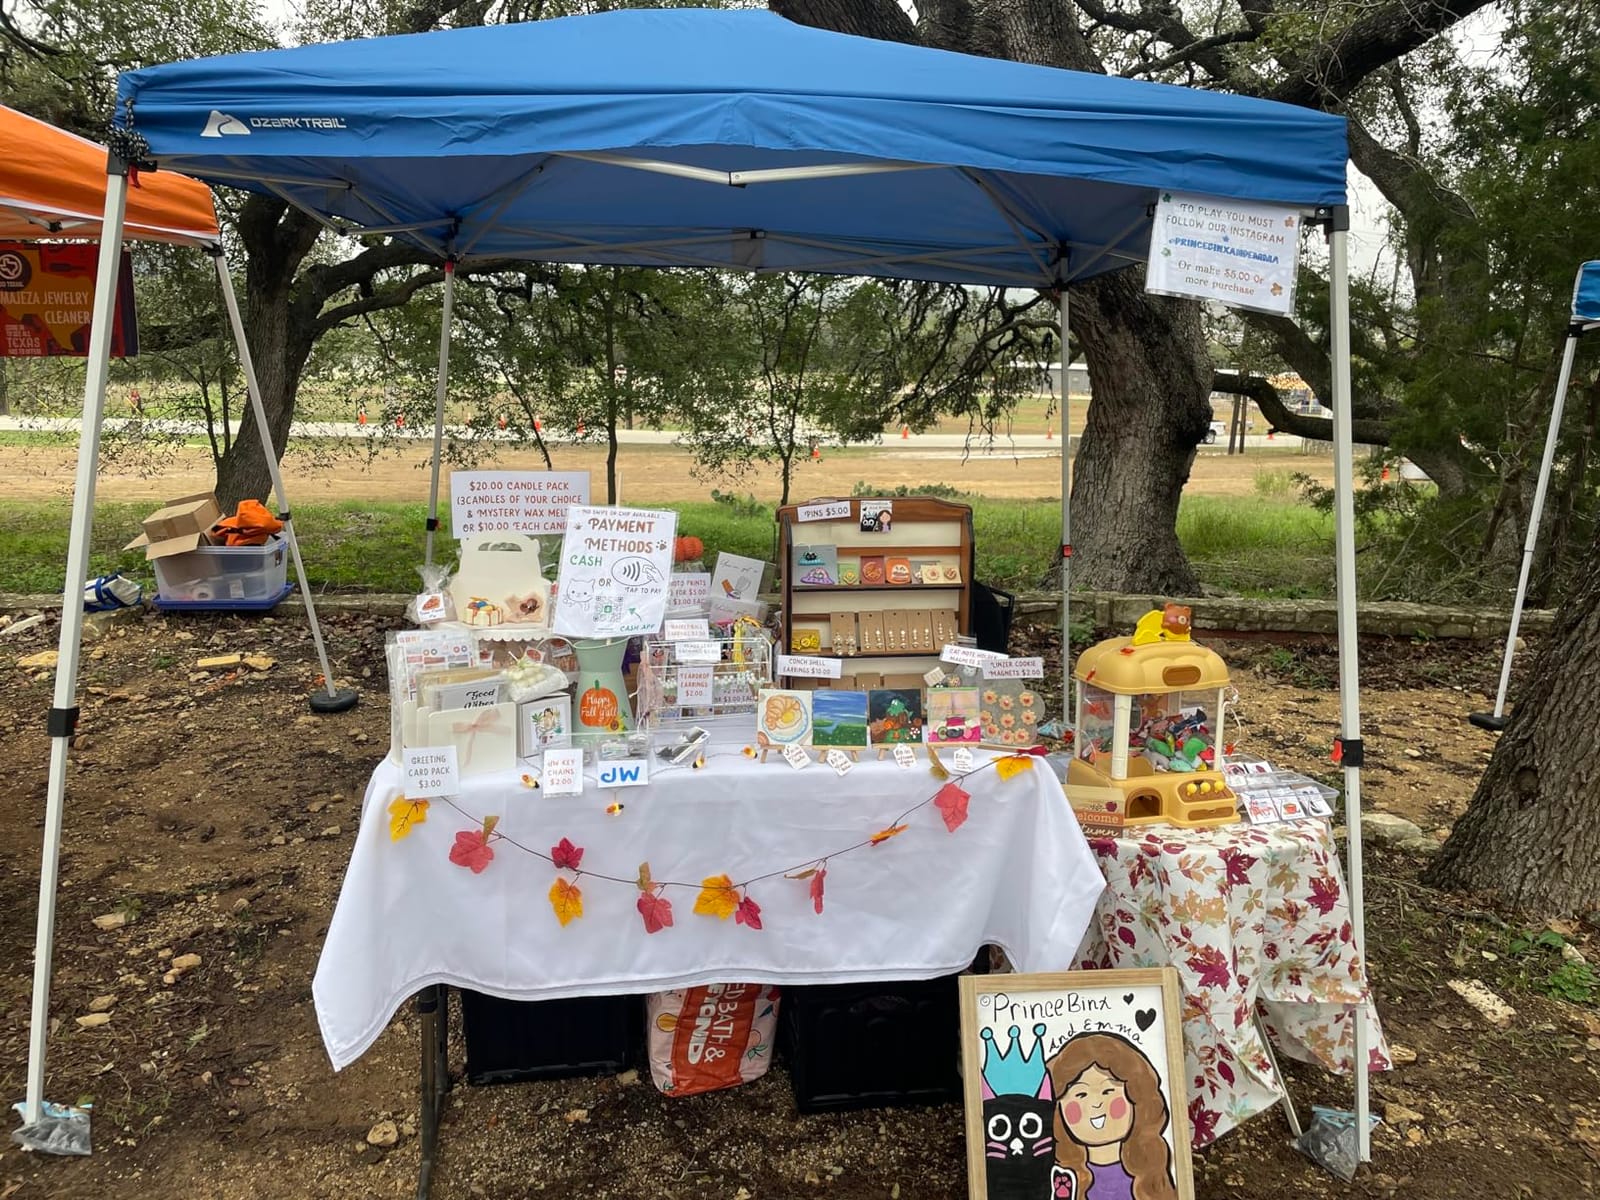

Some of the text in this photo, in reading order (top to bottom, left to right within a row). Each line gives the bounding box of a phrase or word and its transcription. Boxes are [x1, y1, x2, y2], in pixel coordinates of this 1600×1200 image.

[250, 117, 347, 128] OZARK TRAIL
[1180, 203, 1275, 229] TO PLAY YOU MUST
[1166, 214, 1285, 245] FOLLOW OUR INSTAGRAM
[1195, 262, 1221, 275] make
[1224, 268, 1250, 282] $5.00
[1185, 276, 1254, 296] more purchase
[42, 290, 89, 305] JEWELRY
[44, 310, 91, 324] CLEANER
[6, 336, 40, 348] TEXAS
[470, 481, 569, 492] $20.00 CANDLE PACK
[510, 496, 520, 504] OF
[525, 495, 548, 504] YOUR
[552, 495, 582, 504] CHOICE
[477, 508, 520, 518] MYSTERY
[524, 508, 544, 518] WAX
[804, 506, 848, 518] PINS $5.00
[463, 524, 474, 532] OR
[478, 522, 509, 532] $10.00
[512, 522, 540, 530] EACH
[588, 518, 654, 534] PAYMENT
[584, 538, 653, 554] METHODS
[570, 554, 602, 567] CASH
[598, 578, 612, 587] OR
[1015, 660, 1036, 668] COOKIE
[466, 688, 496, 700] Good
[586, 692, 610, 708] Happy
[581, 706, 596, 717] Fall
[411, 754, 446, 765] GREETING
[408, 766, 450, 777] CARD PACK
[548, 768, 574, 776] CHAINS
[601, 766, 640, 783] JW
[418, 780, 442, 789] $3.00
[550, 778, 572, 786] $2.00
[1077, 812, 1119, 824] elcome
[708, 1002, 738, 1046] BATH
[1050, 1018, 1144, 1052] And Emma
[704, 1047, 726, 1064] &
